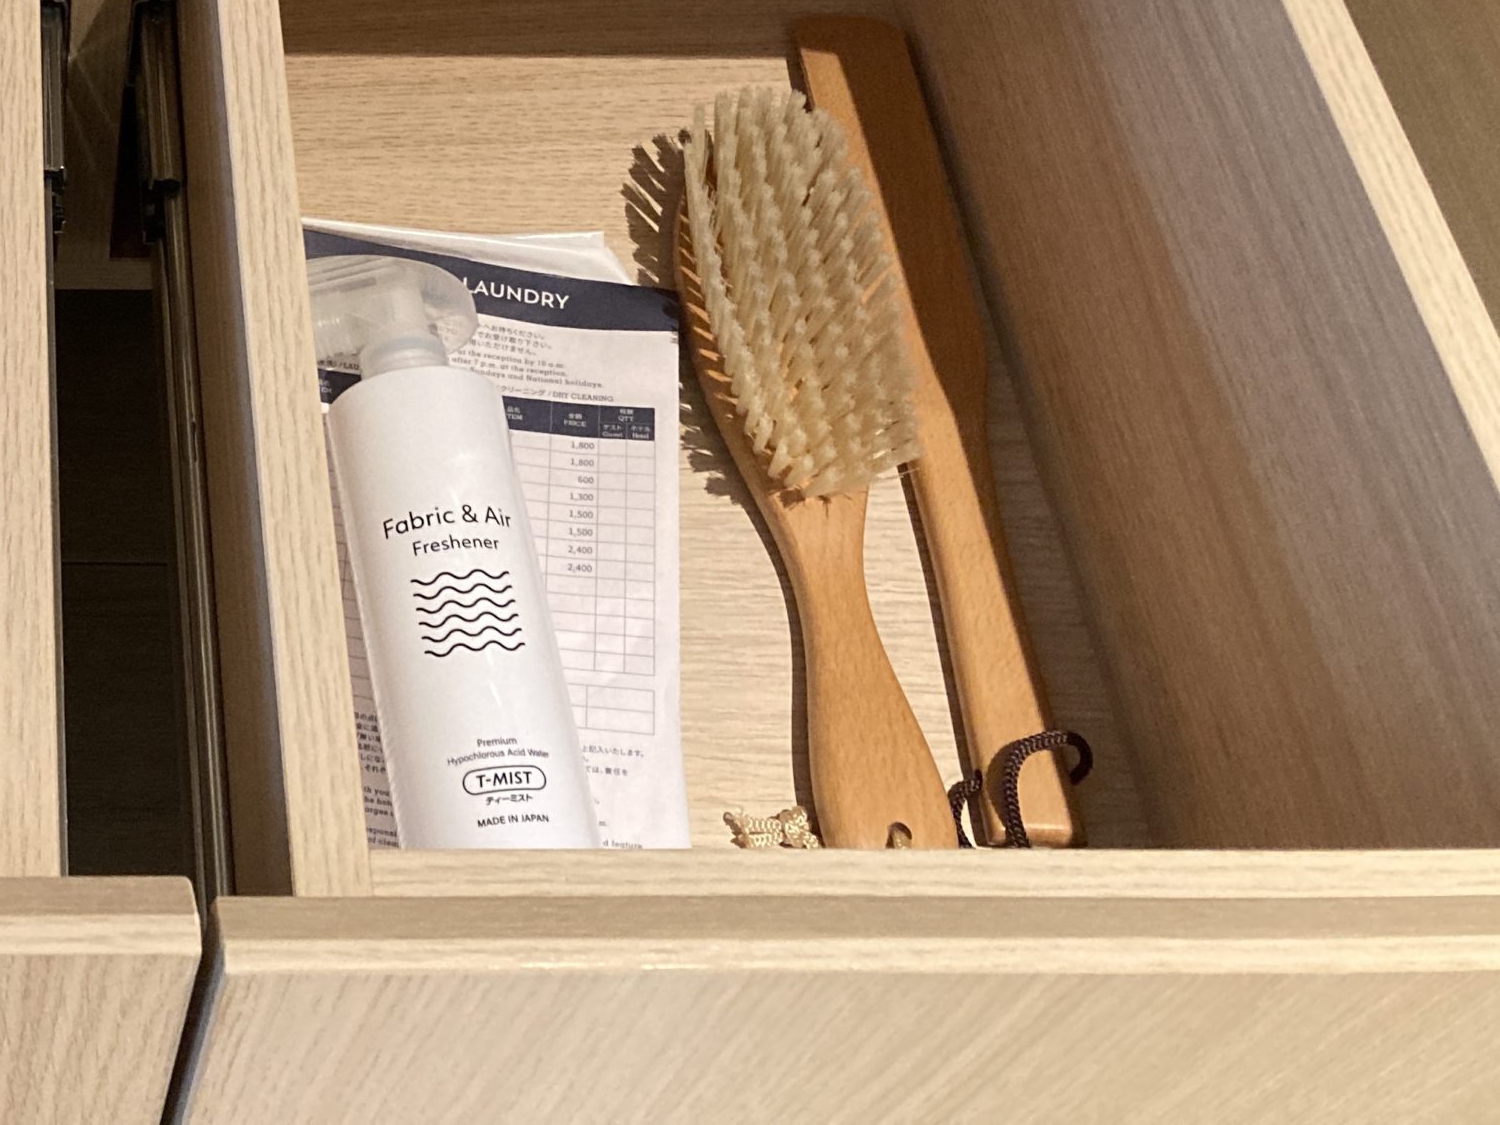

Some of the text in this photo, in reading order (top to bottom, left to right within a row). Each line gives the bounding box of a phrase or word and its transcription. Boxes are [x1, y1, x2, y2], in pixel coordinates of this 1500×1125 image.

[464, 277, 569, 309] LAUNDRY
[526, 376, 563, 385] National
[569, 510, 593, 520] 1,500
[383, 505, 511, 539] Fabric & Air
[569, 527, 593, 538] 1,500
[412, 534, 500, 556] Freshener
[568, 545, 593, 555] 2,400
[567, 563, 592, 574] 2,400
[477, 737, 517, 747] Premium
[447, 748, 549, 766] Hypochlorous Acid Water
[476, 771, 532, 788] T-MIST
[486, 794, 533, 805] ティーミスト
[477, 814, 549, 827] MADE IN JAPAN
